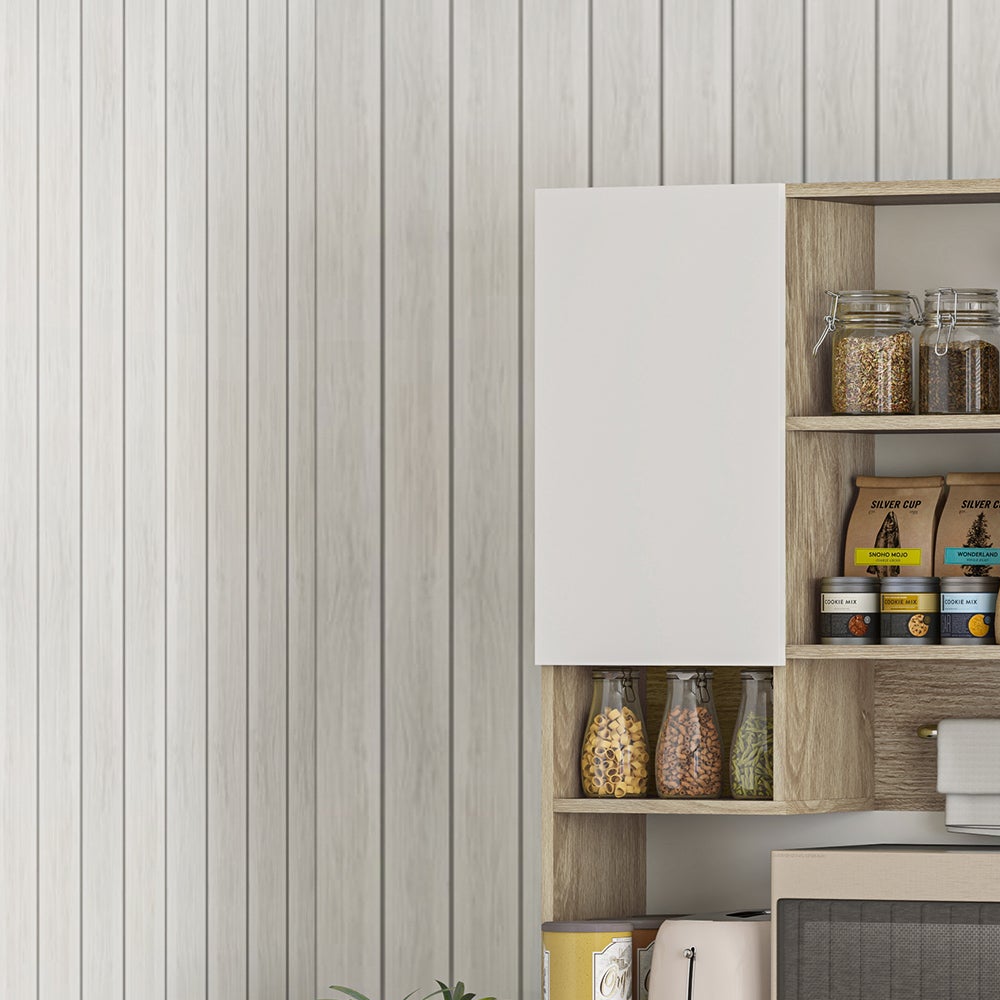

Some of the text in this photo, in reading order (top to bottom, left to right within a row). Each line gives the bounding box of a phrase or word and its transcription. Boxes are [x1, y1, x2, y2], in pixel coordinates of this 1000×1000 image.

[871, 500, 922, 509] SILVER CUP
[961, 500, 991, 509] SILVER
